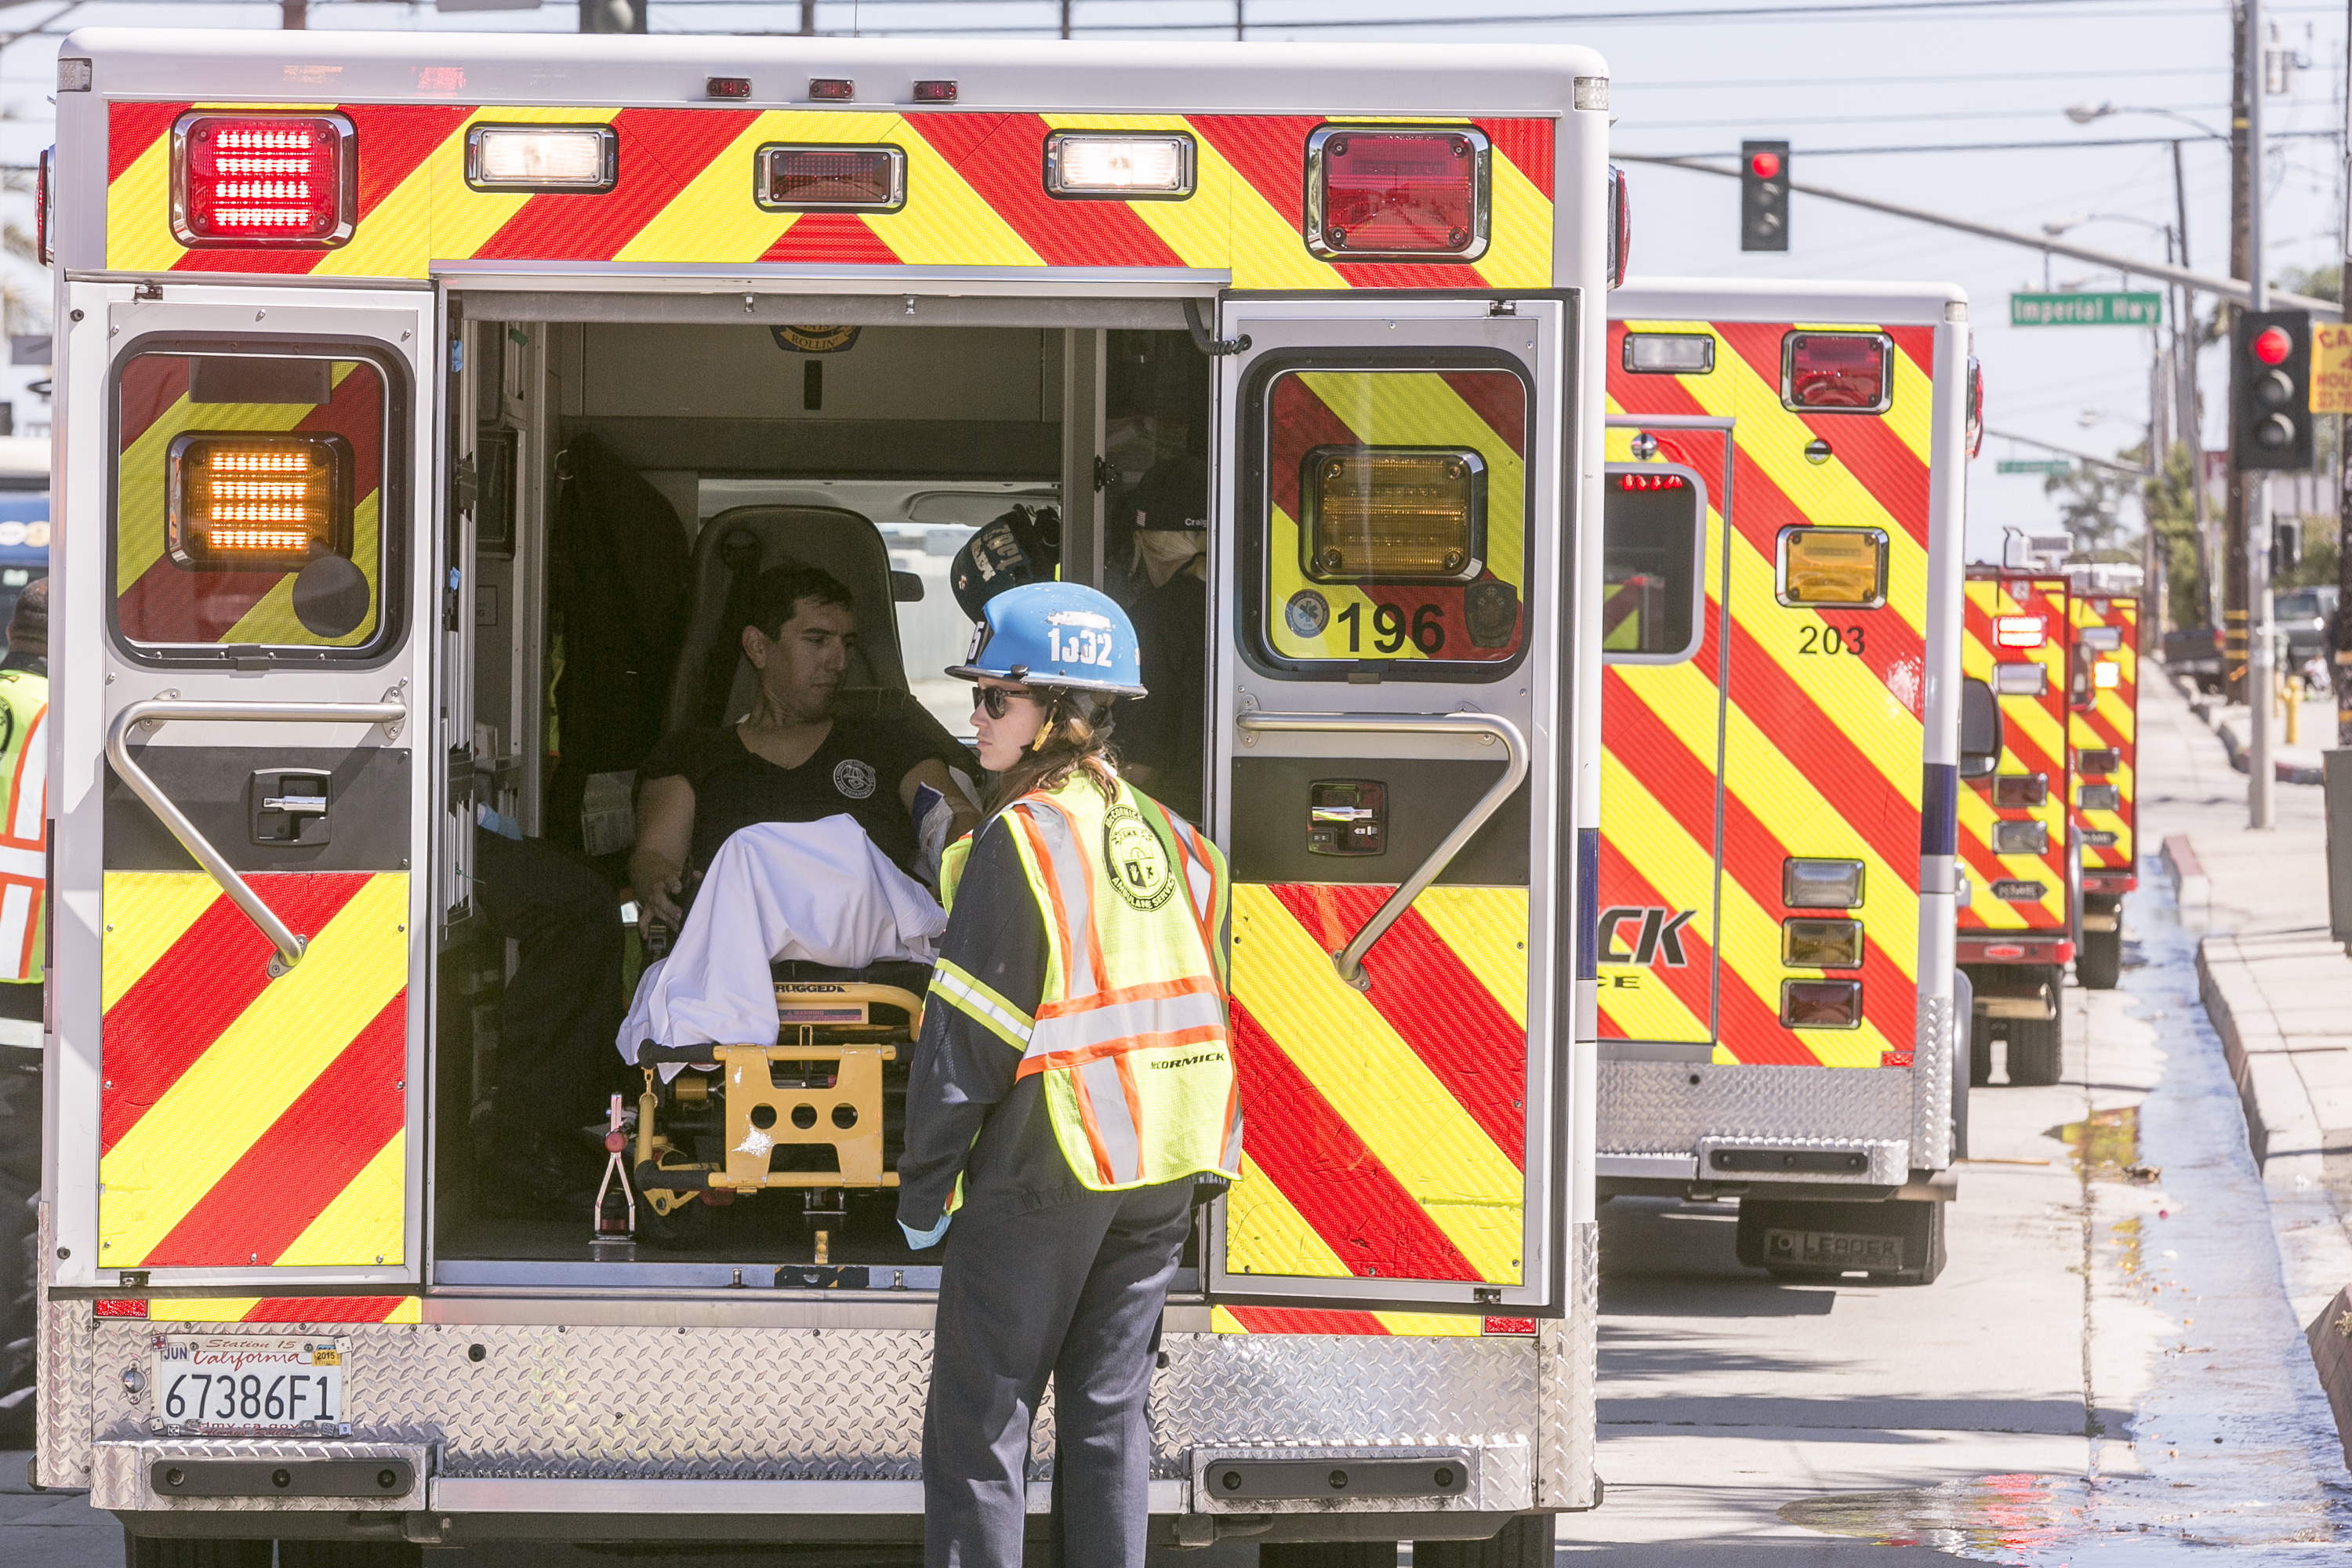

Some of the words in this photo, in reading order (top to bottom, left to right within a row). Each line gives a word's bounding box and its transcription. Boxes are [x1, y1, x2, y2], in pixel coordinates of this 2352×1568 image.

[2014, 297, 2103, 325] Imperial
[2112, 297, 2158, 325] Hwy
[1338, 602, 1445, 654] 196
[1798, 626, 1865, 655] 203
[1105, 806, 1144, 829] McCORMICK
[775, 985, 837, 993] RUGGED
[1803, 1233, 1894, 1255] LEADER
[163, 1346, 188, 1361] JUN
[205, 1339, 270, 1349] Station
[278, 1340, 297, 1349] 15
[193, 1350, 314, 1372] California
[316, 1352, 336, 1361] 2015
[165, 1374, 334, 1421] 67386F1
[203, 1428, 248, 1436] Always
[252, 1428, 299, 1437] Rolling
